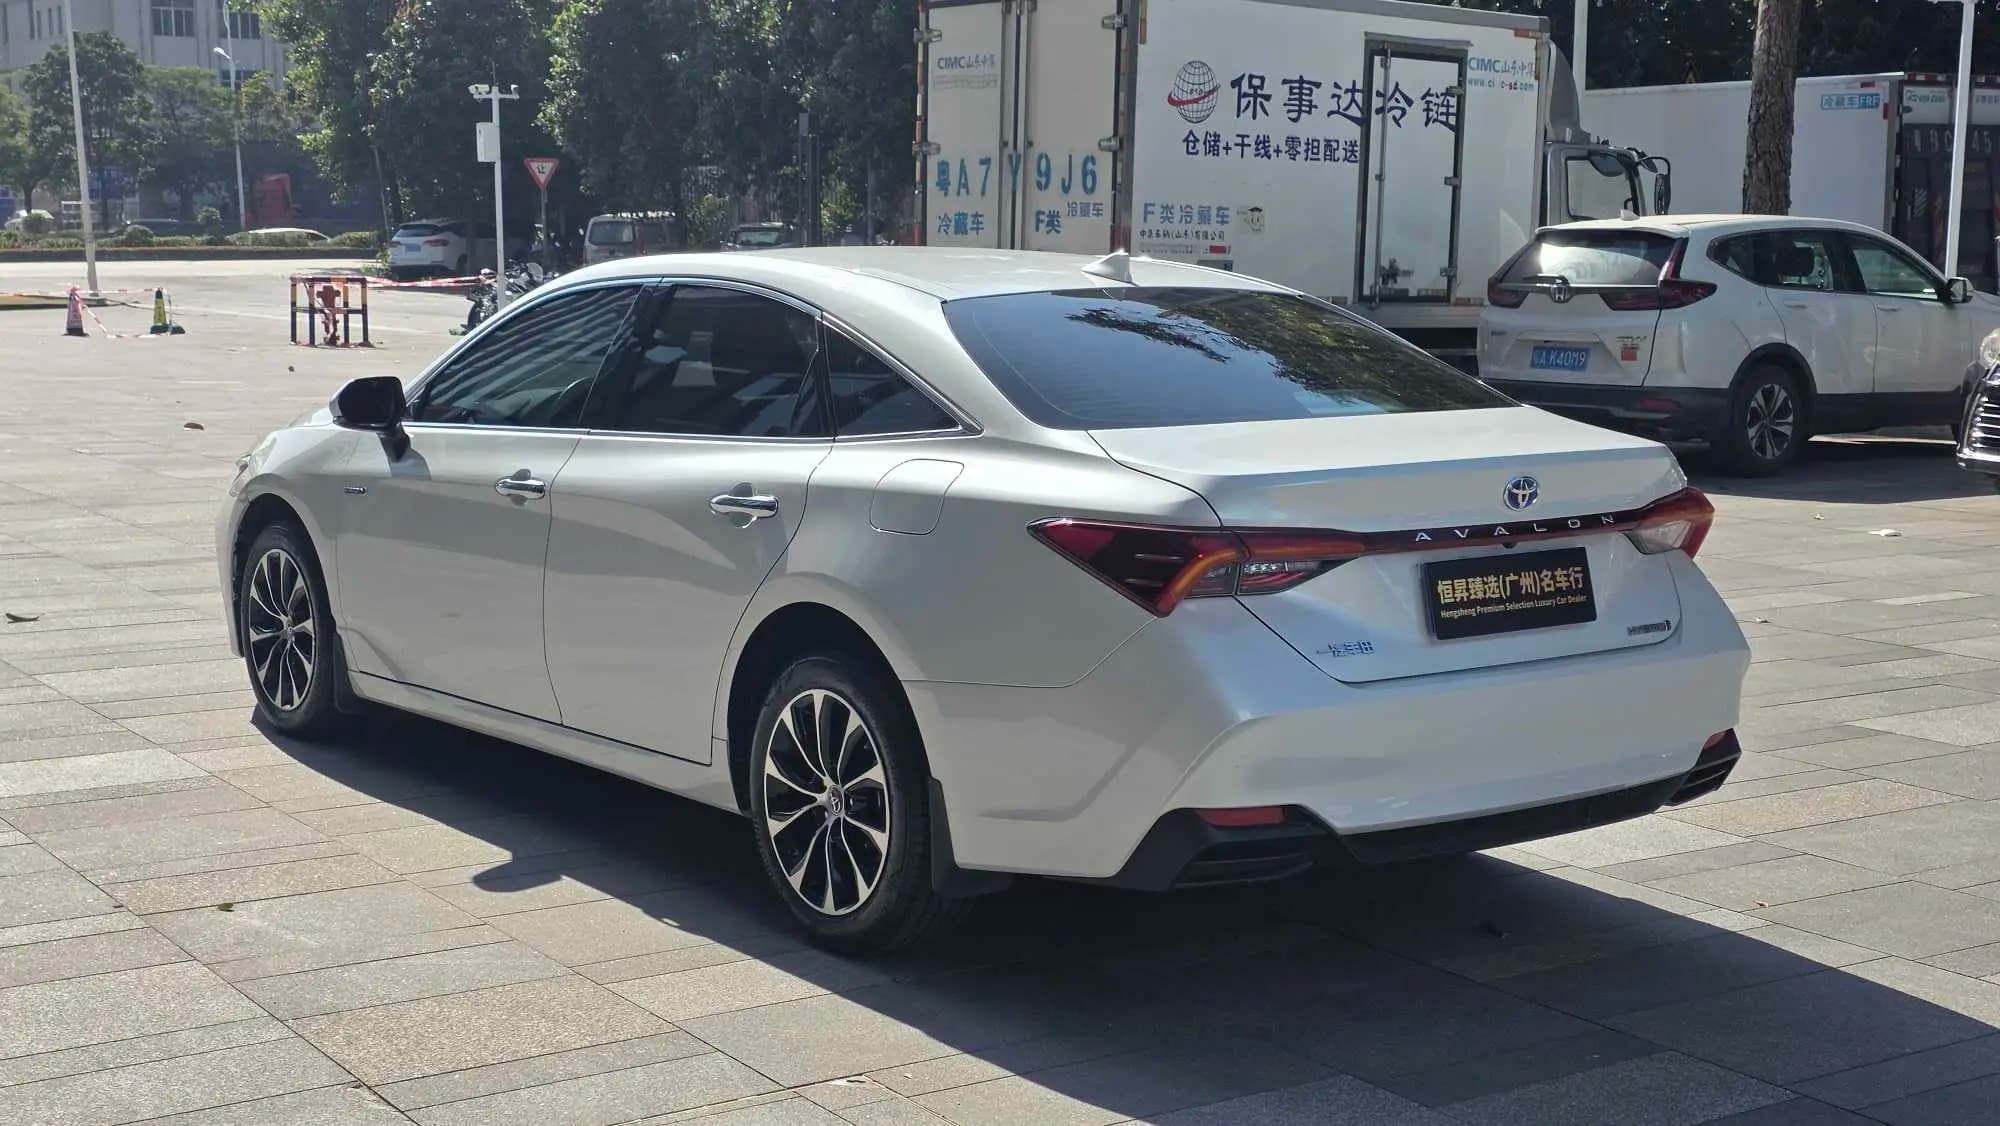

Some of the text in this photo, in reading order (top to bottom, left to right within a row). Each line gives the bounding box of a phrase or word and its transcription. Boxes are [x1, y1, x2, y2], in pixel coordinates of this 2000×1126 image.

[1230, 72, 1457, 132] 保事达冷链
[1182, 129, 1359, 163] 仓储+干线+零担配送
[536, 162, 549, 174] 让
[1067, 201, 1104, 218] 冷藏车
[937, 211, 985, 235] 冷藏车
[1035, 210, 1062, 235] F类
[1415, 514, 1615, 542] AVALON
[1437, 567, 1584, 604] 恒昇臻选(广州)名车行
[1440, 594, 1587, 619] Hengsheng Premium Selection Luxury Car Dealer
